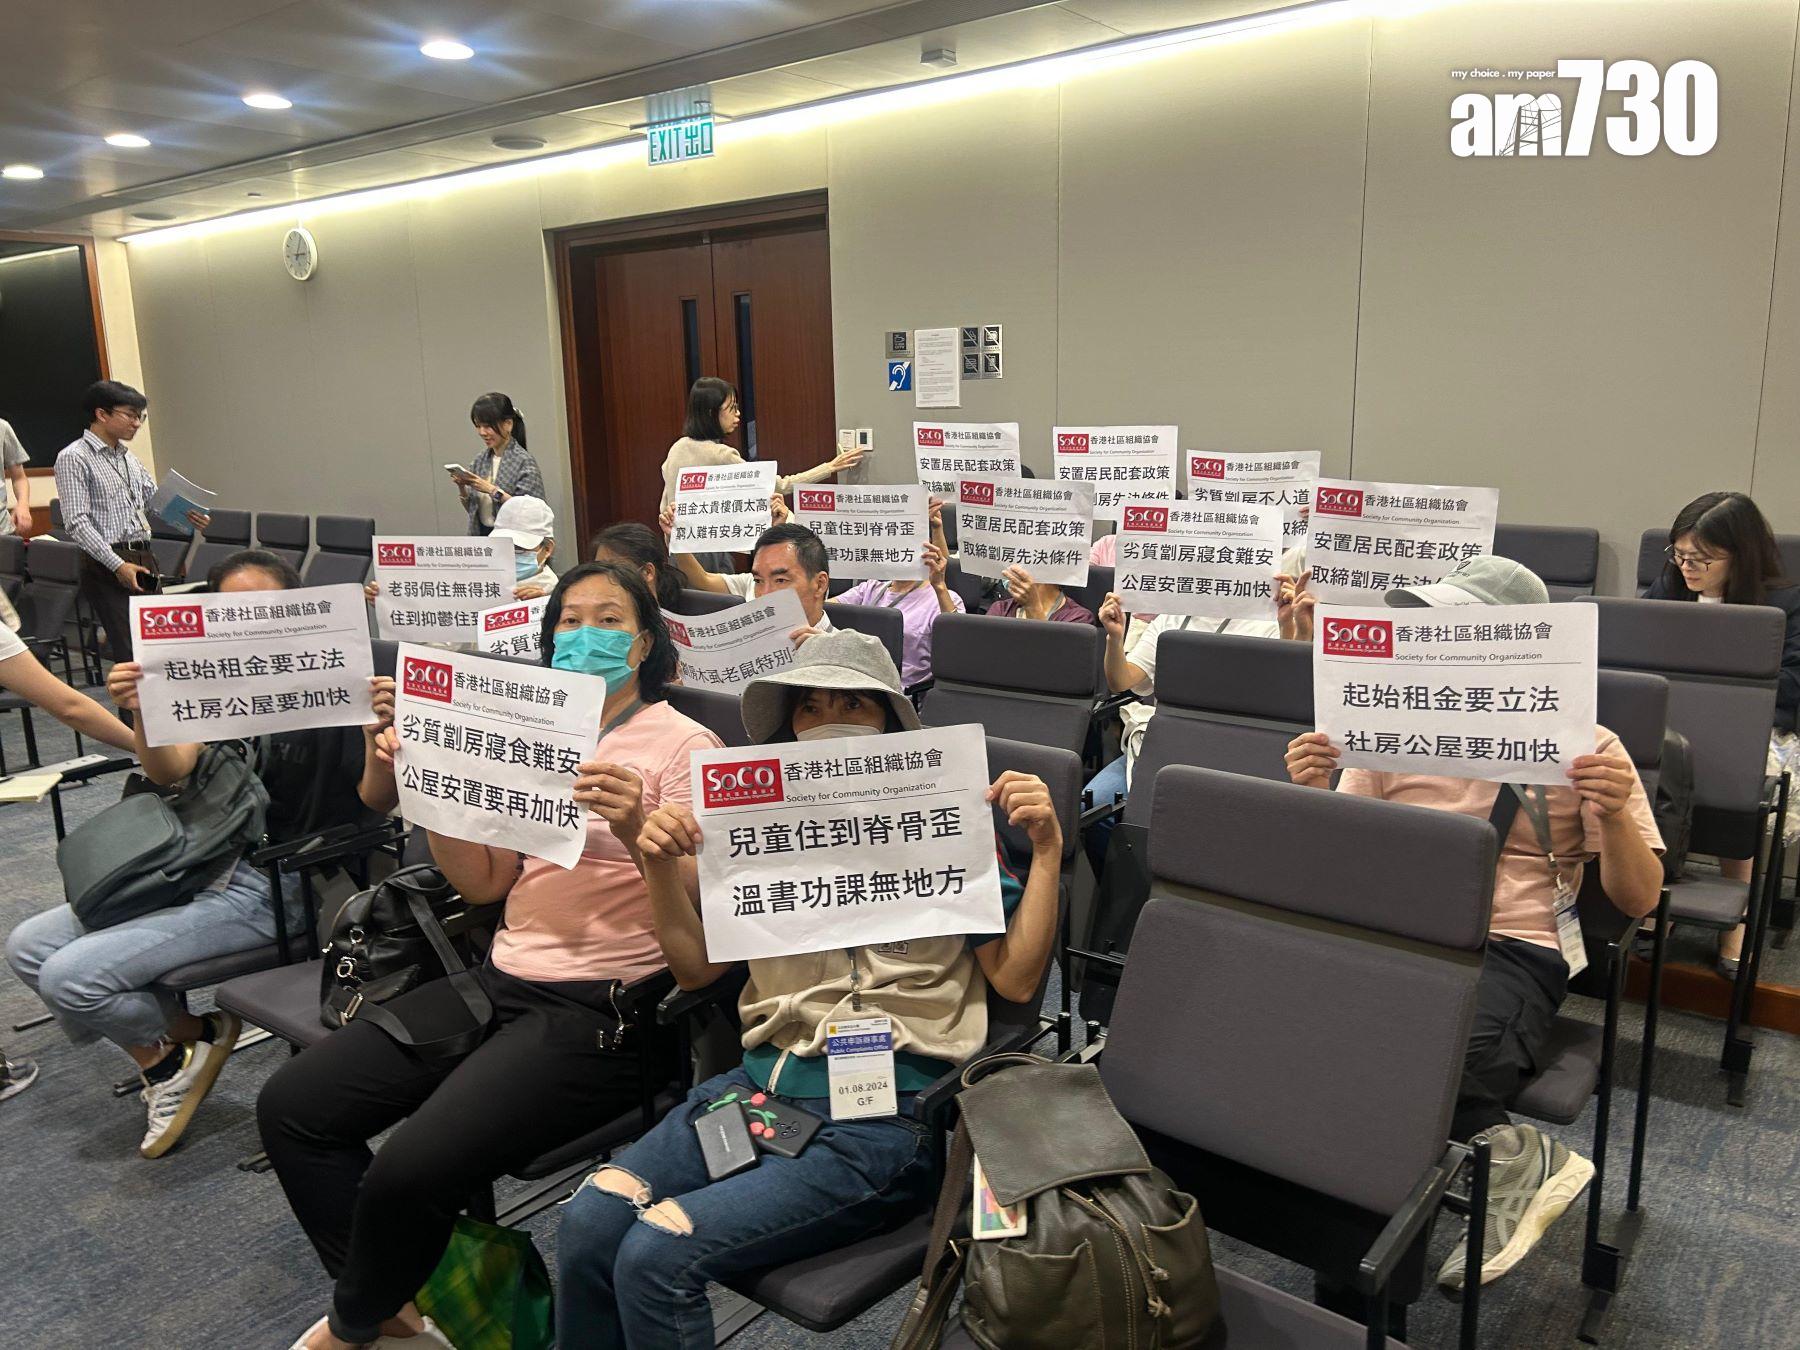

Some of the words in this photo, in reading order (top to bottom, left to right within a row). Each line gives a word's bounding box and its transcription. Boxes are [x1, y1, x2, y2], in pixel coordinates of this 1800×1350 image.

[650, 127, 682, 162] EXIT
[685, 122, 713, 157] 出口
[1090, 434, 1159, 444] 香港社區組織協會
[920, 457, 1015, 472] 安置居民配套政策
[1059, 466, 1170, 480] 安置居民配套政策
[1226, 460, 1300, 472] 香港社區組織協會
[801, 492, 832, 504] SoCO
[836, 494, 909, 504] 香港社區組織協會
[962, 484, 991, 498] SoCO
[995, 487, 1073, 501] 香港社區組織協會
[1319, 489, 1358, 507] SoCO
[677, 498, 767, 516] 租金太貴樓價太高
[1364, 494, 1468, 512] 香港社區組織協會
[961, 513, 1085, 537] 安置居民配套政策
[1127, 509, 1164, 523] SoCO
[1169, 511, 1260, 525] 香港社區組織協會
[809, 521, 915, 537] 兒童住到脊骨歪
[379, 545, 412, 558] SoCO
[416, 546, 493, 557] 香港社區組織協會
[963, 541, 1082, 565] 取締劏房先決條件
[1123, 542, 1273, 566] 劣質劏房寢食難安
[1314, 531, 1482, 561] 安置居民配套政策
[1121, 574, 1271, 598] 公屋安置要再加快
[142, 609, 198, 628] SoCO
[205, 600, 332, 623] 香港社區組織協會
[1326, 622, 1387, 644] SoCO
[1395, 621, 1552, 643] 香港社區組織協會
[164, 648, 345, 682] 起始租金要立法
[1395, 653, 1423, 662] Society
[1426, 653, 1437, 661] for
[1440, 654, 1487, 663] Community
[1489, 652, 1542, 663] Organization
[406, 661, 449, 688] SoCO
[454, 671, 568, 708] 香港社區組織協會
[1342, 681, 1560, 714] 起始租金要立法
[172, 687, 350, 722] 社房公屋要加快
[453, 699, 471, 711] Society
[472, 703, 481, 711] for
[482, 705, 514, 719] Community
[514, 712, 555, 726] Organization
[402, 714, 581, 777] 劣質劏房寢食難安
[1344, 730, 1561, 764] 社房公屋要加快
[784, 747, 944, 783] 香港社區組織協會
[706, 766, 775, 792] SoCO
[402, 764, 580, 830] 公屋安置要再加快
[786, 794, 816, 803] Society
[818, 792, 831, 800] for
[832, 788, 881, 799] Community
[882, 782, 937, 796] Organization
[729, 806, 963, 858] 兒童住到脊骨歪
[732, 864, 967, 917] 溫書功課無地方
[838, 1081, 888, 1095] 01.08.2024
